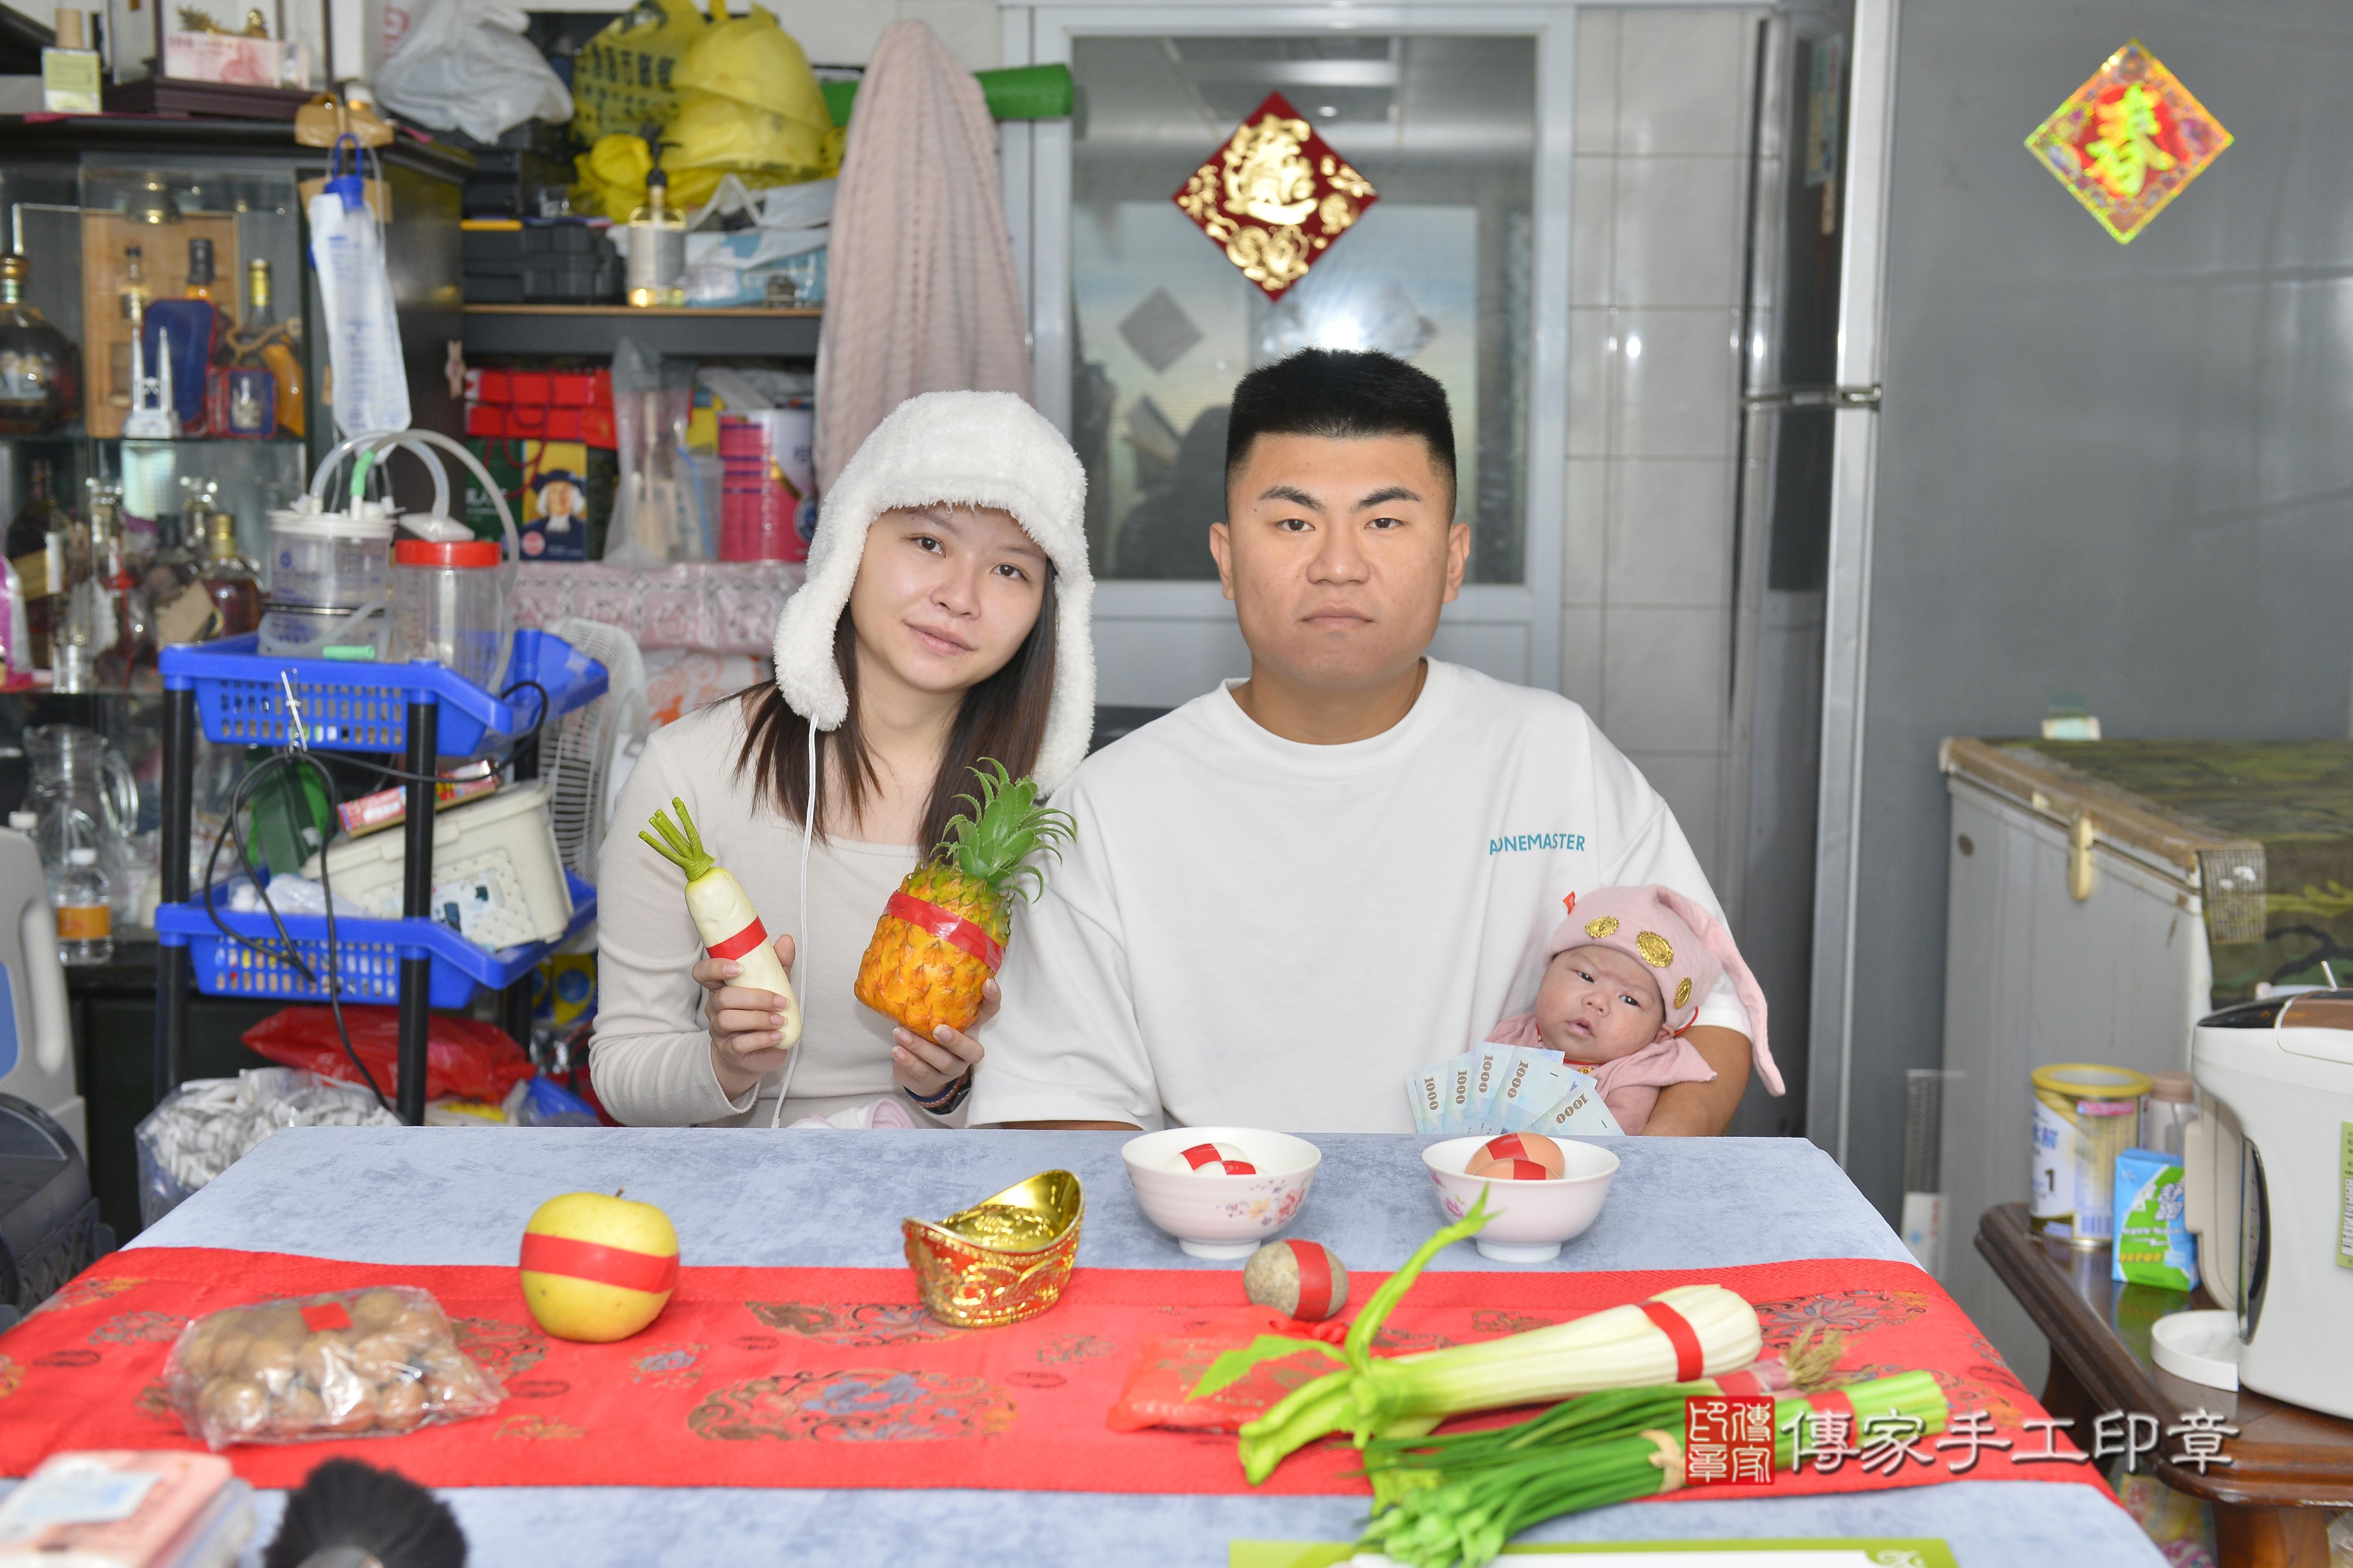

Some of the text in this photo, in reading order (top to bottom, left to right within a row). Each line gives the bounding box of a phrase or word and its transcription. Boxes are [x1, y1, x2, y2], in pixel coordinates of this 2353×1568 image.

[1455, 1070, 1467, 1104] 1000
[1478, 1054, 1493, 1093] 1000
[1507, 1059, 1529, 1098] 1000
[1424, 1076, 1438, 1110] 1000
[1556, 1093, 1589, 1124] 1000
[2044, 1169, 2055, 1192] 1
